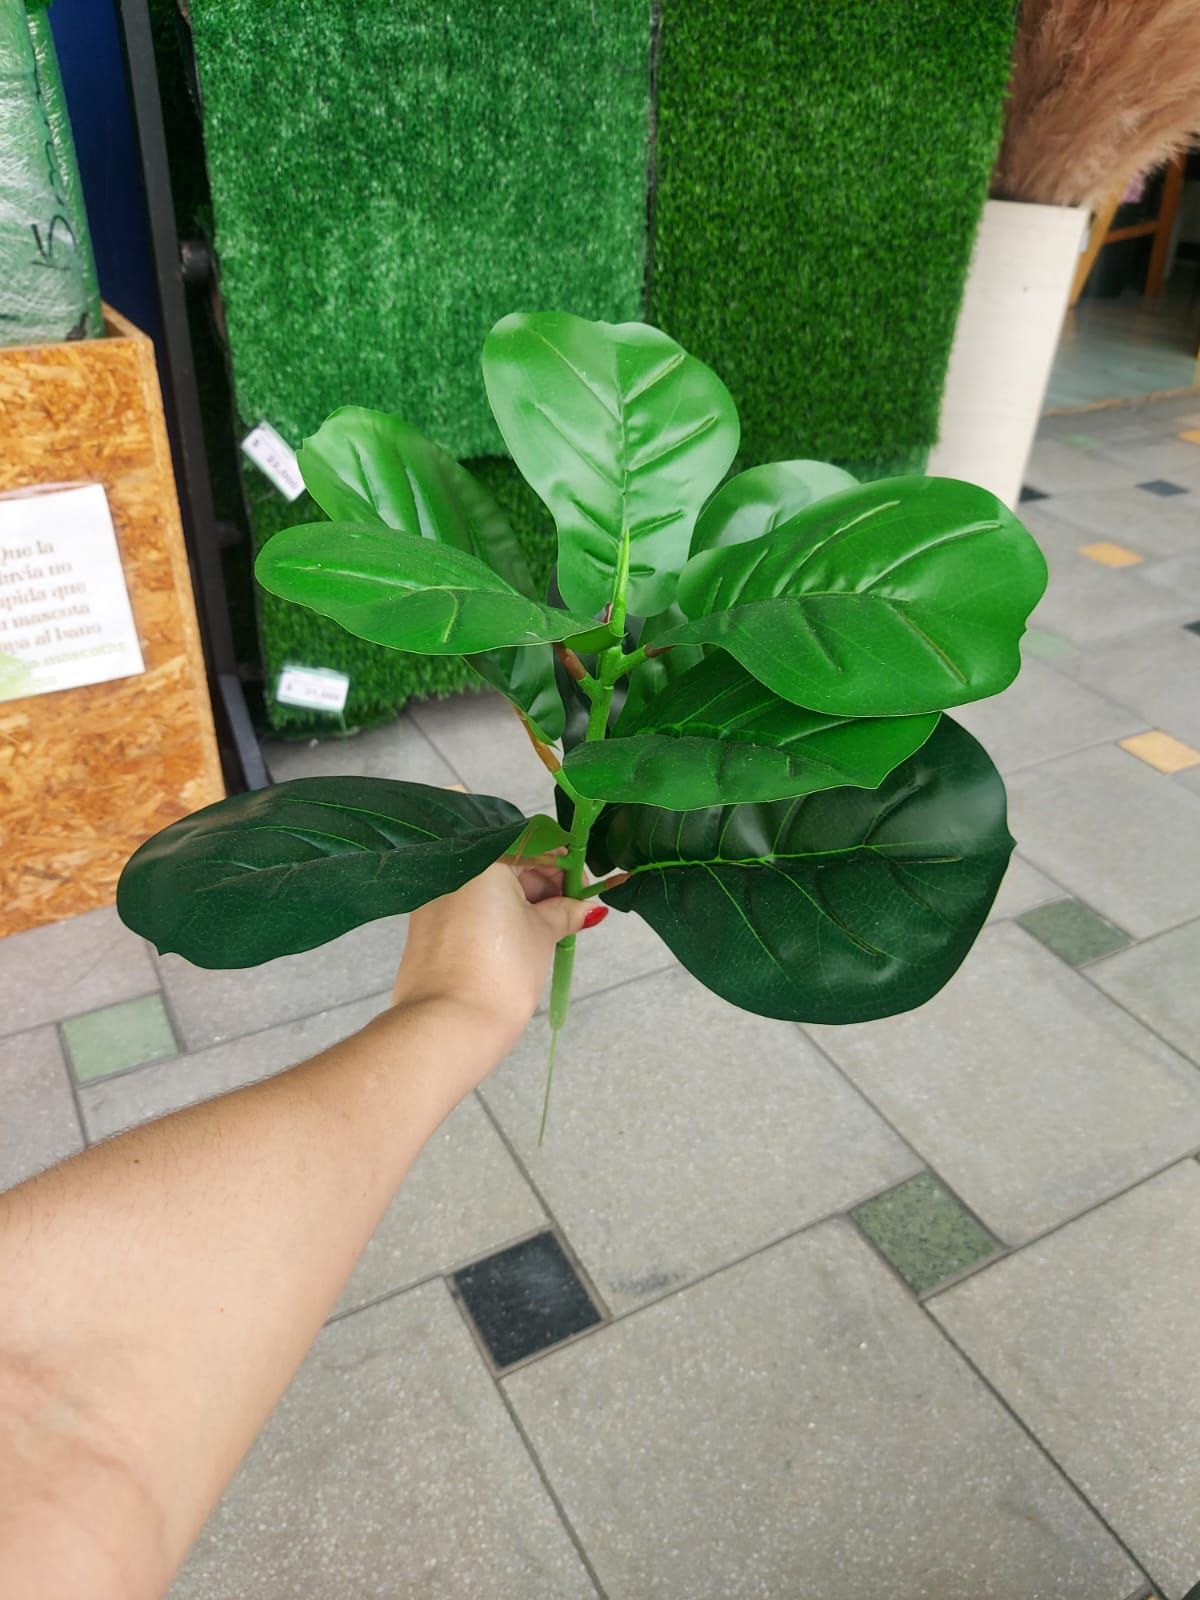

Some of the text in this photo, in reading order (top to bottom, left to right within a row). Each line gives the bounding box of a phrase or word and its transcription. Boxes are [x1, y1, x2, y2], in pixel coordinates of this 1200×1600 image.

[36, 540, 55, 555] la
[48, 561, 73, 577] no
[12, 602, 90, 629] mascota
